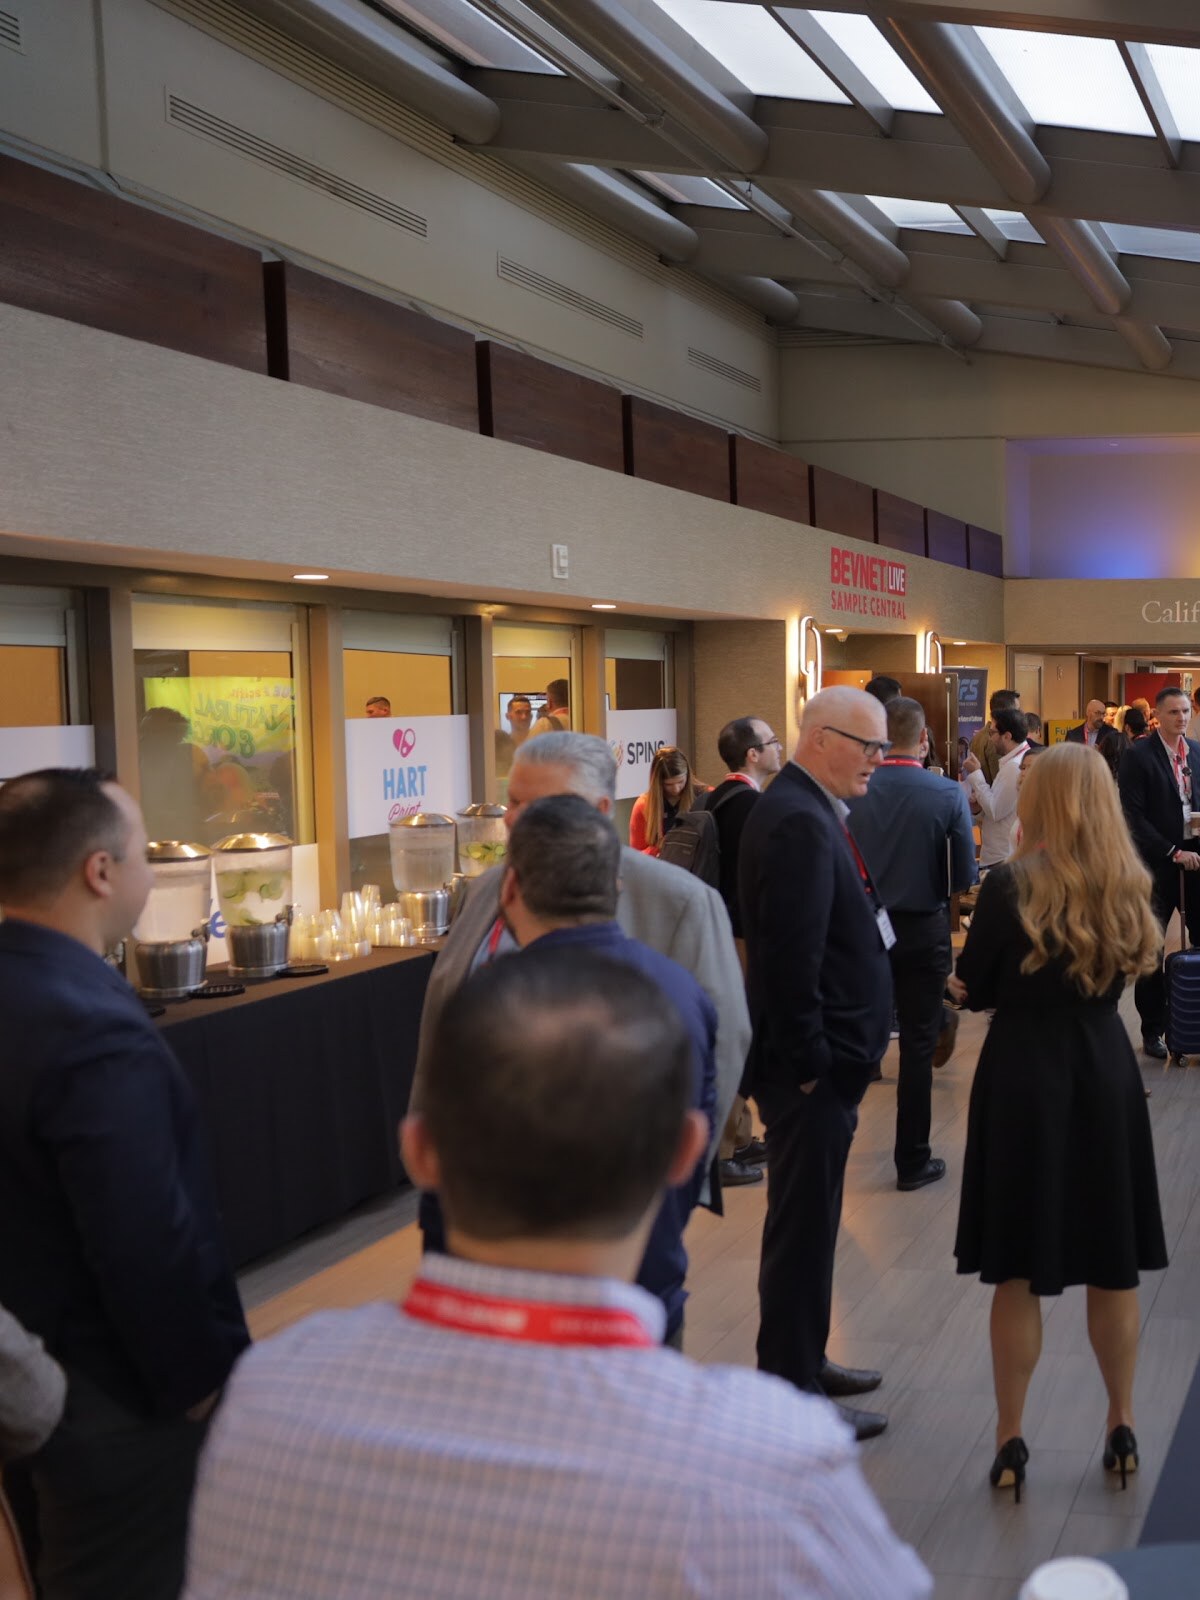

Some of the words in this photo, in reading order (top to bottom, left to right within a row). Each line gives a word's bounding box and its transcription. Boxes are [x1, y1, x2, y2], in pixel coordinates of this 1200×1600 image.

[888, 565, 905, 592] LIVE
[831, 590, 867, 615] SAMPLE
[870, 597, 906, 620] CENTRAL
[383, 765, 427, 800] HART
[388, 801, 421, 821] Print
